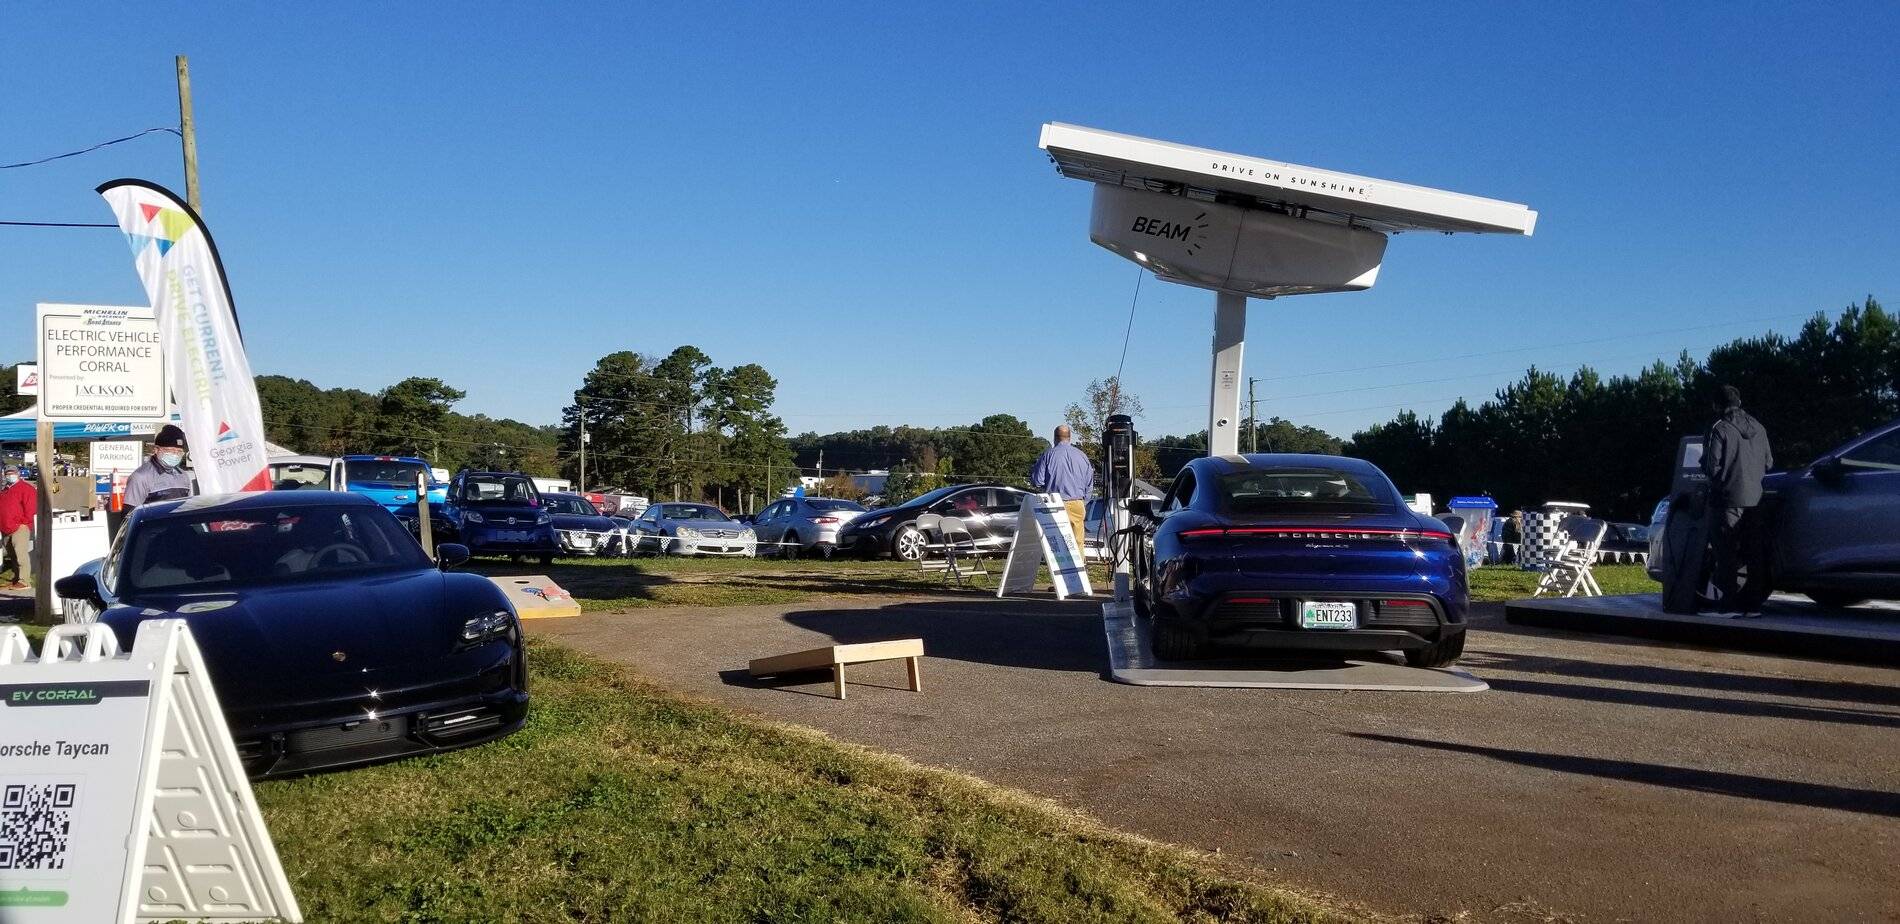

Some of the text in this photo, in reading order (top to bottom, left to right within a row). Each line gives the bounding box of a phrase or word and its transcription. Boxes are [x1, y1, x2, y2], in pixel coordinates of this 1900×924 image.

[1212, 162, 1365, 195] DRIVE ON SUNSHINE
[1131, 216, 1192, 242] BEAM
[183, 264, 202, 297] GET
[166, 268, 190, 322] DRIVE
[48, 329, 160, 343] ELECTRIC VEHICLE
[56, 344, 151, 358] PERFORMANCE
[79, 360, 130, 373] CORRAL
[75, 384, 134, 397] JACKSON
[83, 423, 116, 433] POWER
[117, 424, 130, 432] OF
[99, 453, 133, 461] PARKING
[210, 442, 253, 459] Georgia
[217, 454, 251, 468] Power
[1316, 609, 1352, 622] ENT233
[12, 689, 97, 701] EV CORRAL
[0, 740, 109, 759] orsche Taycan
